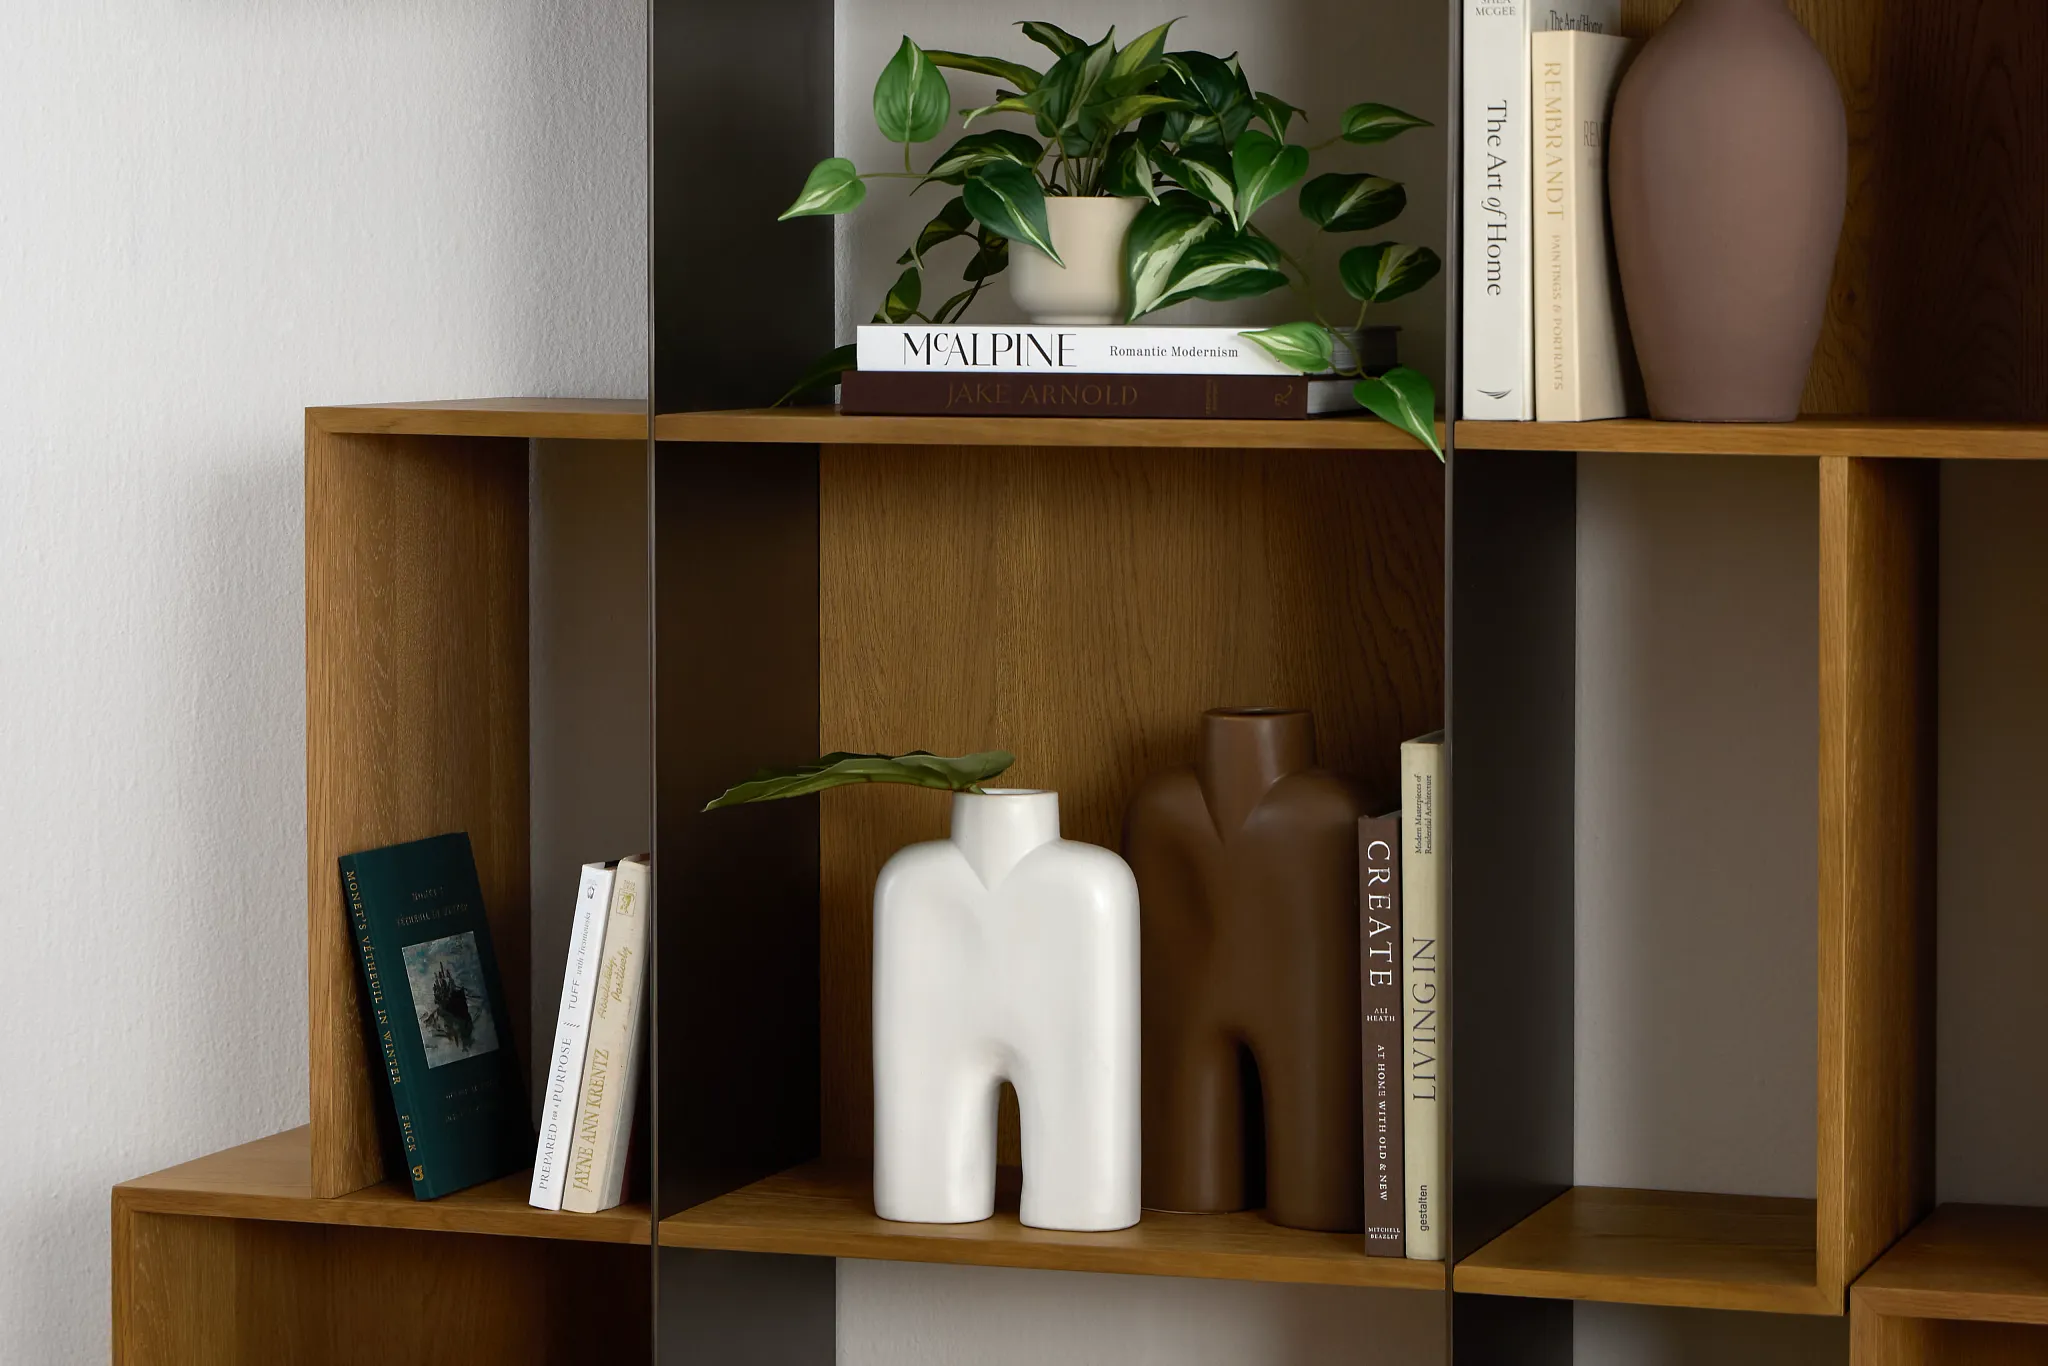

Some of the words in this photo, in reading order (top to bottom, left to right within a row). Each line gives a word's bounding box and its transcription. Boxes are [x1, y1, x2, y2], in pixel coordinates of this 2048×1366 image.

[1475, 6, 1517, 16] MCGEE
[1550, 9, 1563, 31] The
[1564, 12, 1576, 31] Art
[1487, 99, 1507, 147] The
[1544, 62, 1565, 221] REMBRANDT
[1487, 152, 1507, 191] Art
[1481, 197, 1507, 220] of
[1487, 222, 1507, 297] Home
[1551, 234, 1562, 300] PAINTINGS
[1109, 345, 1167, 357] Romantic
[1171, 345, 1239, 358] Modernism
[1553, 318, 1563, 391] PORTRAITS
[945, 382, 1011, 409] JAKE
[1020, 384, 1138, 407] ARNOLD
[1413, 774, 1422, 783] of
[1424, 774, 1432, 817] Architecture
[1414, 783, 1424, 826] Masterpieces
[1414, 827, 1422, 854] Modern
[1424, 818, 1432, 854] Residential
[1367, 839, 1393, 987] CREATE
[1412, 936, 1436, 973] IN
[346, 870, 367, 930] MONET'S
[362, 935, 383, 1004] VÉTHEUIL
[377, 1009, 389, 1025] IN
[383, 1030, 401, 1085] WINTER
[568, 978, 580, 1010] TUFF
[576, 957, 584, 975] with
[1377, 1044, 1385, 1060] AT
[1411, 983, 1437, 1102] LIVING
[586, 1048, 609, 1109] KRENTZ
[1377, 1063, 1386, 1097] HOME
[539, 1123, 558, 1190] PREPARED
[552, 1037, 572, 1103] PURPOSE
[580, 1109, 600, 1145] ANN
[1378, 1100, 1387, 1133] WITH
[401, 1114, 417, 1153] FRICK
[1378, 1136, 1387, 1160] OLD
[572, 1147, 594, 1192] JAYNE
[1379, 1163, 1387, 1171] &
[1379, 1175, 1388, 1201] NEW
[1418, 1184, 1430, 1232] gestalten
